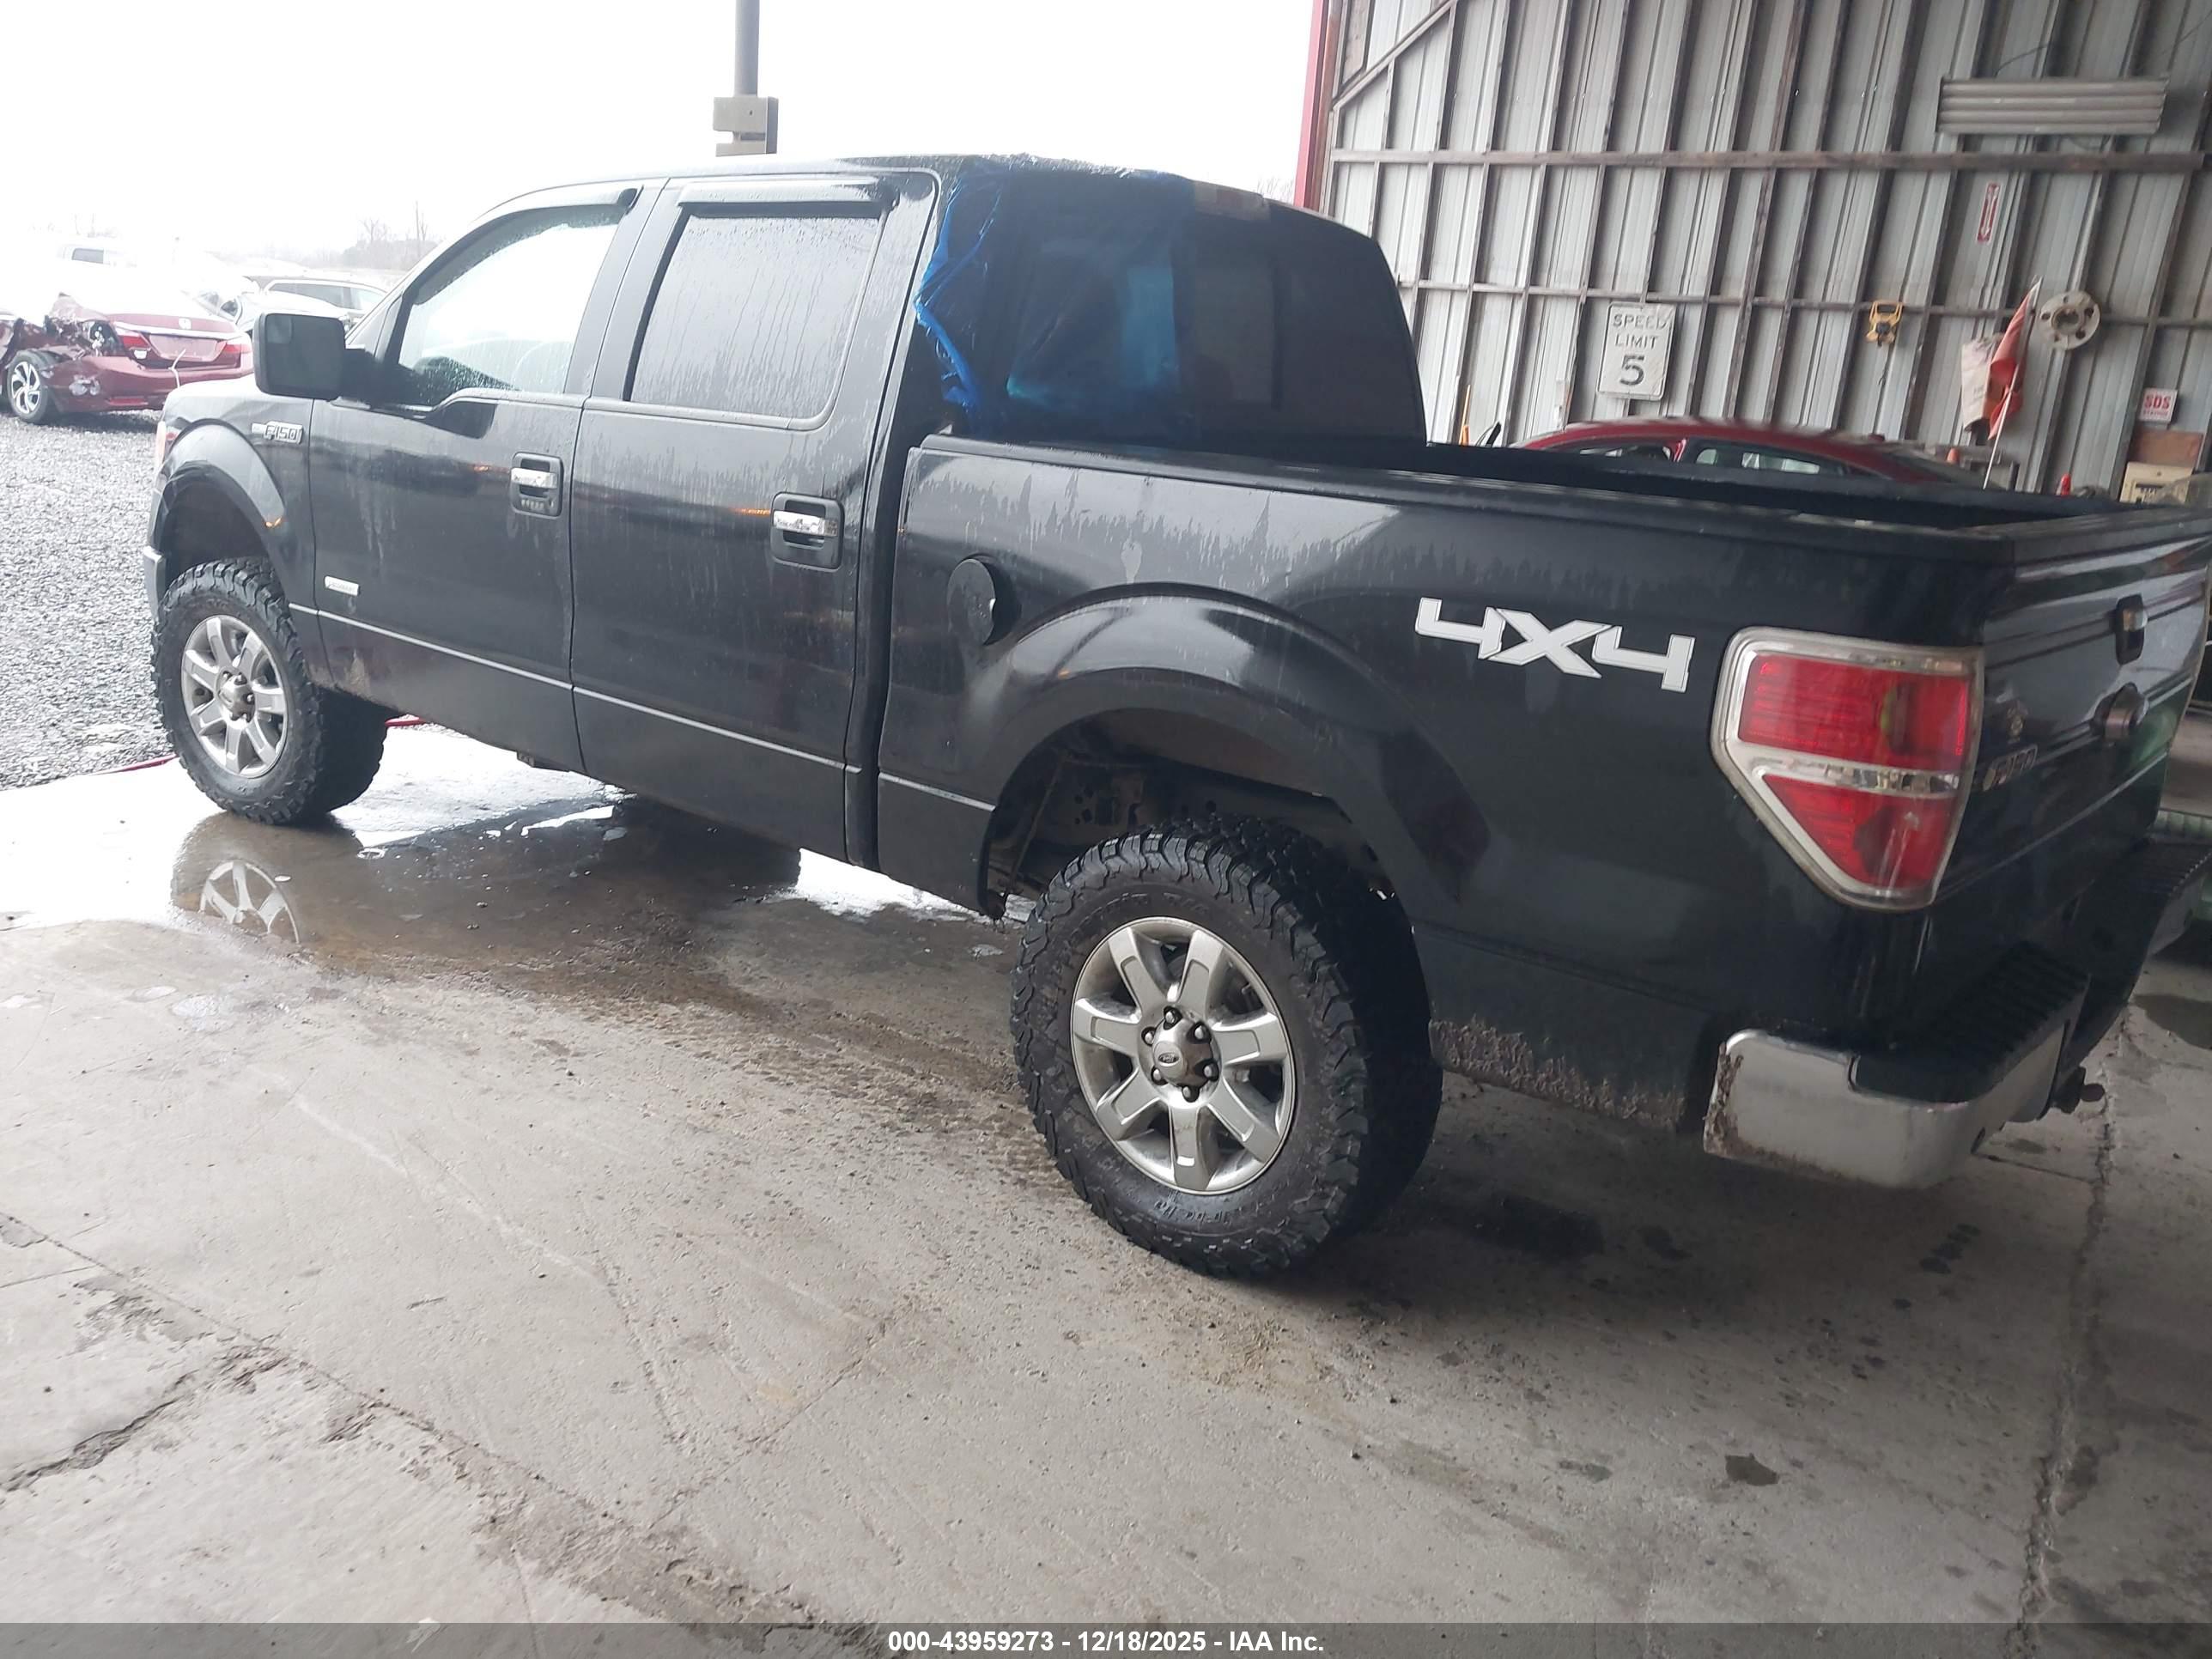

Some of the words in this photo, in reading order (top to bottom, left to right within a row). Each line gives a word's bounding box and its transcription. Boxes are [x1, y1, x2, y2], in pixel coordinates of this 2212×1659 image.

[1613, 313, 1668, 330] SPEED
[1614, 333, 1659, 349] LIMIT
[1620, 355, 1645, 386] 5
[2144, 395, 2172, 410] SDS
